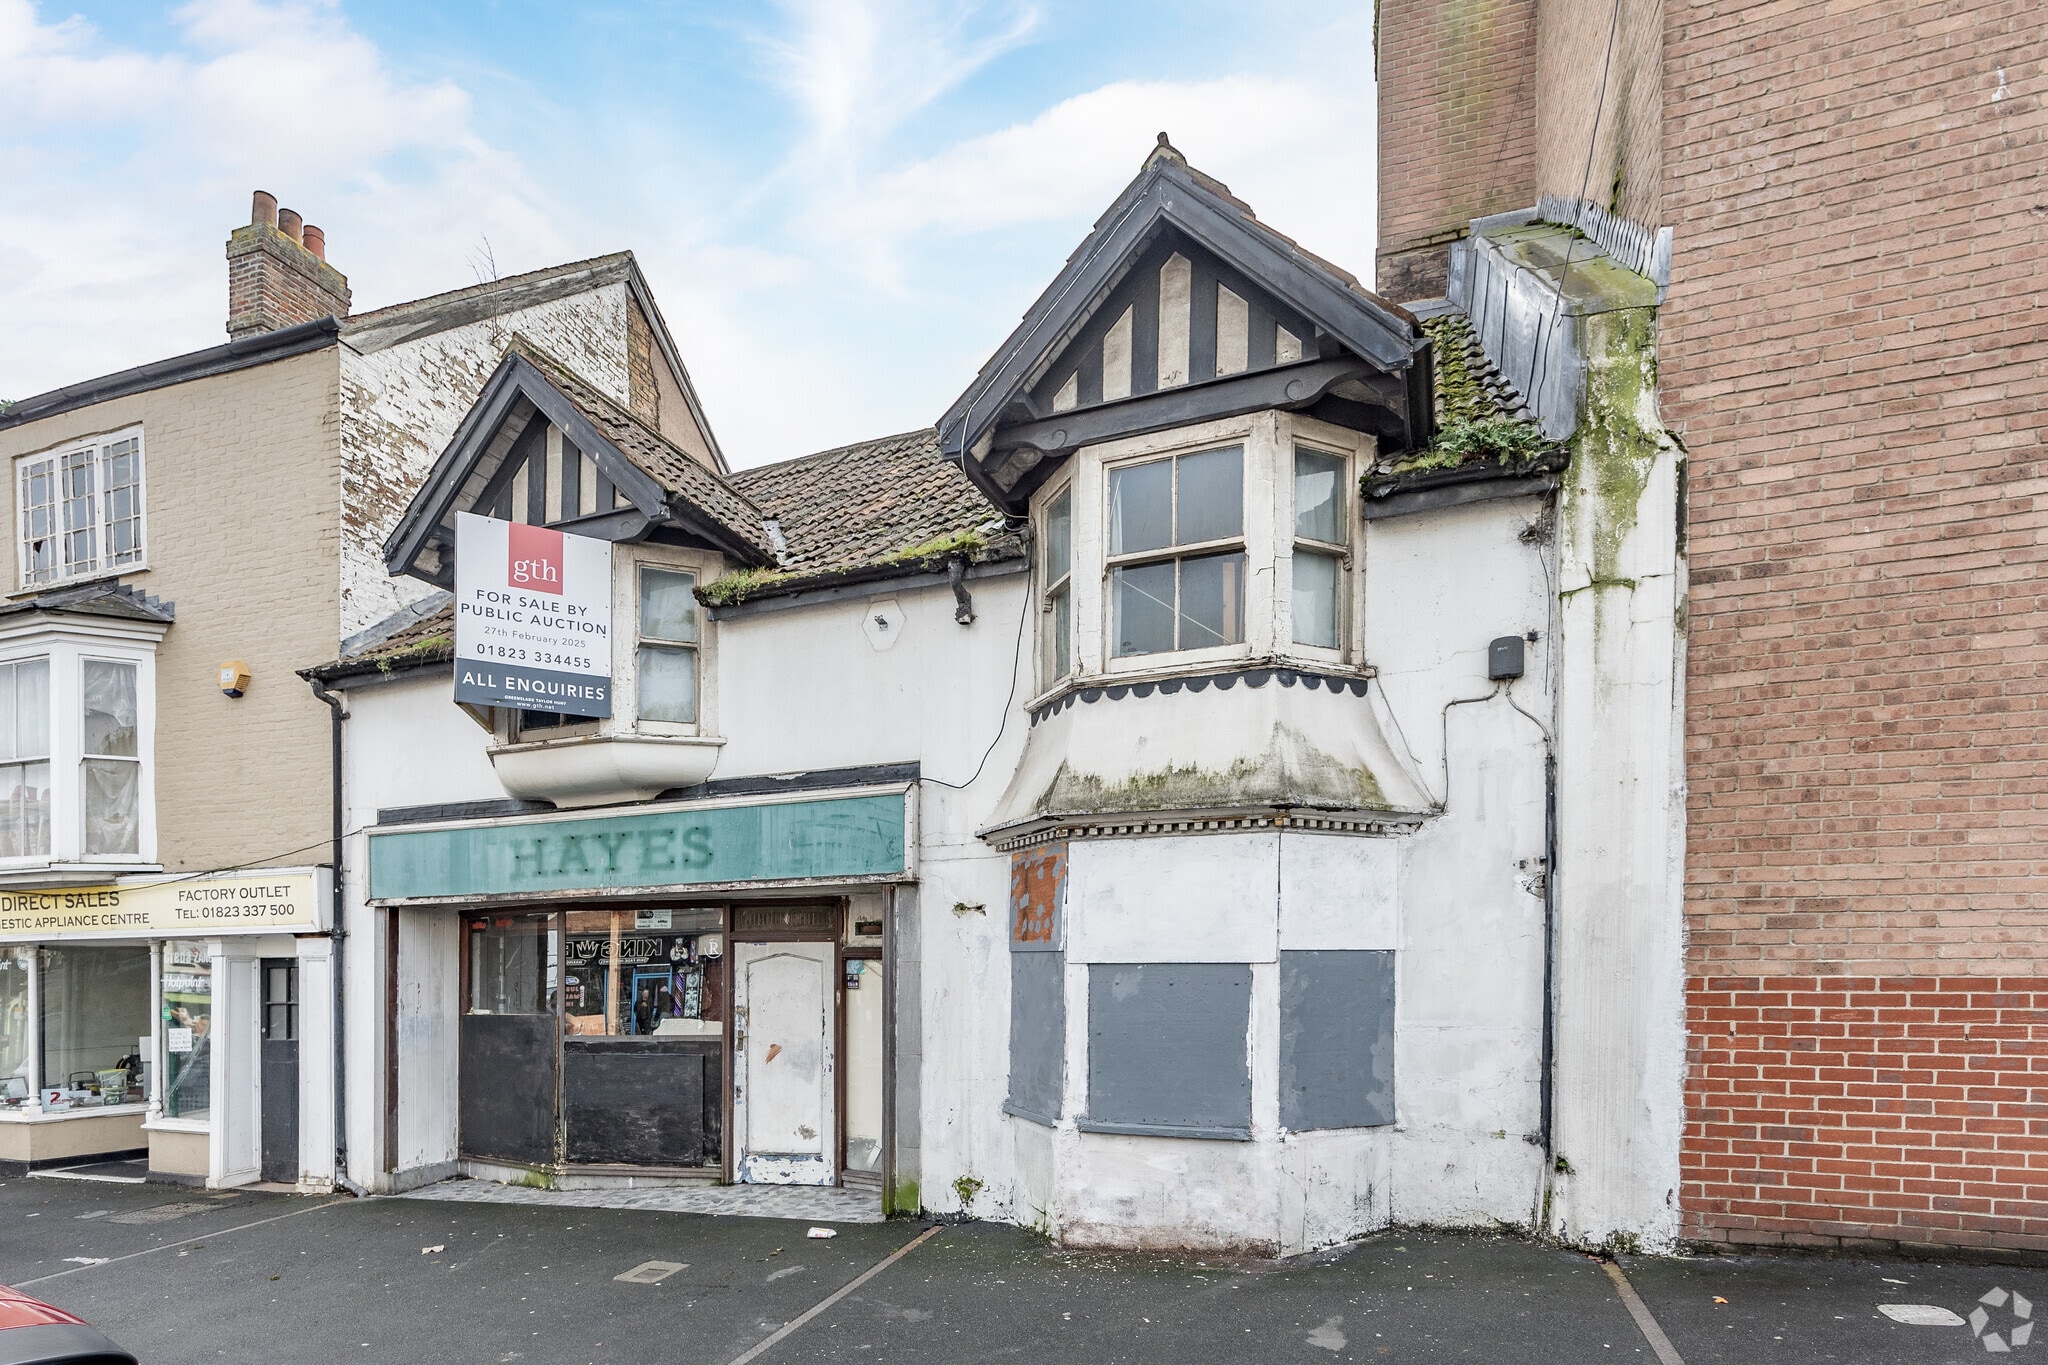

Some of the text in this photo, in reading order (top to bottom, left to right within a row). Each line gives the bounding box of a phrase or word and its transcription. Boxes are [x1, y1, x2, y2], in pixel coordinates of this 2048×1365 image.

[513, 558, 558, 583] gth
[476, 589, 588, 617] FOR SALE BY
[460, 602, 607, 635] PUBLIC AUCTION
[484, 626, 586, 648] 27th February 2025
[476, 643, 591, 669] 01823 334455
[462, 671, 605, 701] ALL ENQUIRIES
[516, 702, 555, 710] www.gth.net
[510, 826, 714, 882] HAYES
[2, 891, 120, 912] DIRECT SALES
[178, 885, 291, 902] FACTORY OUTLET
[0, 912, 150, 930] ESTIC APPLIANCE CENTRE
[202, 905, 240, 919] 01823
[242, 904, 267, 917] 337
[269, 903, 295, 916] 500
